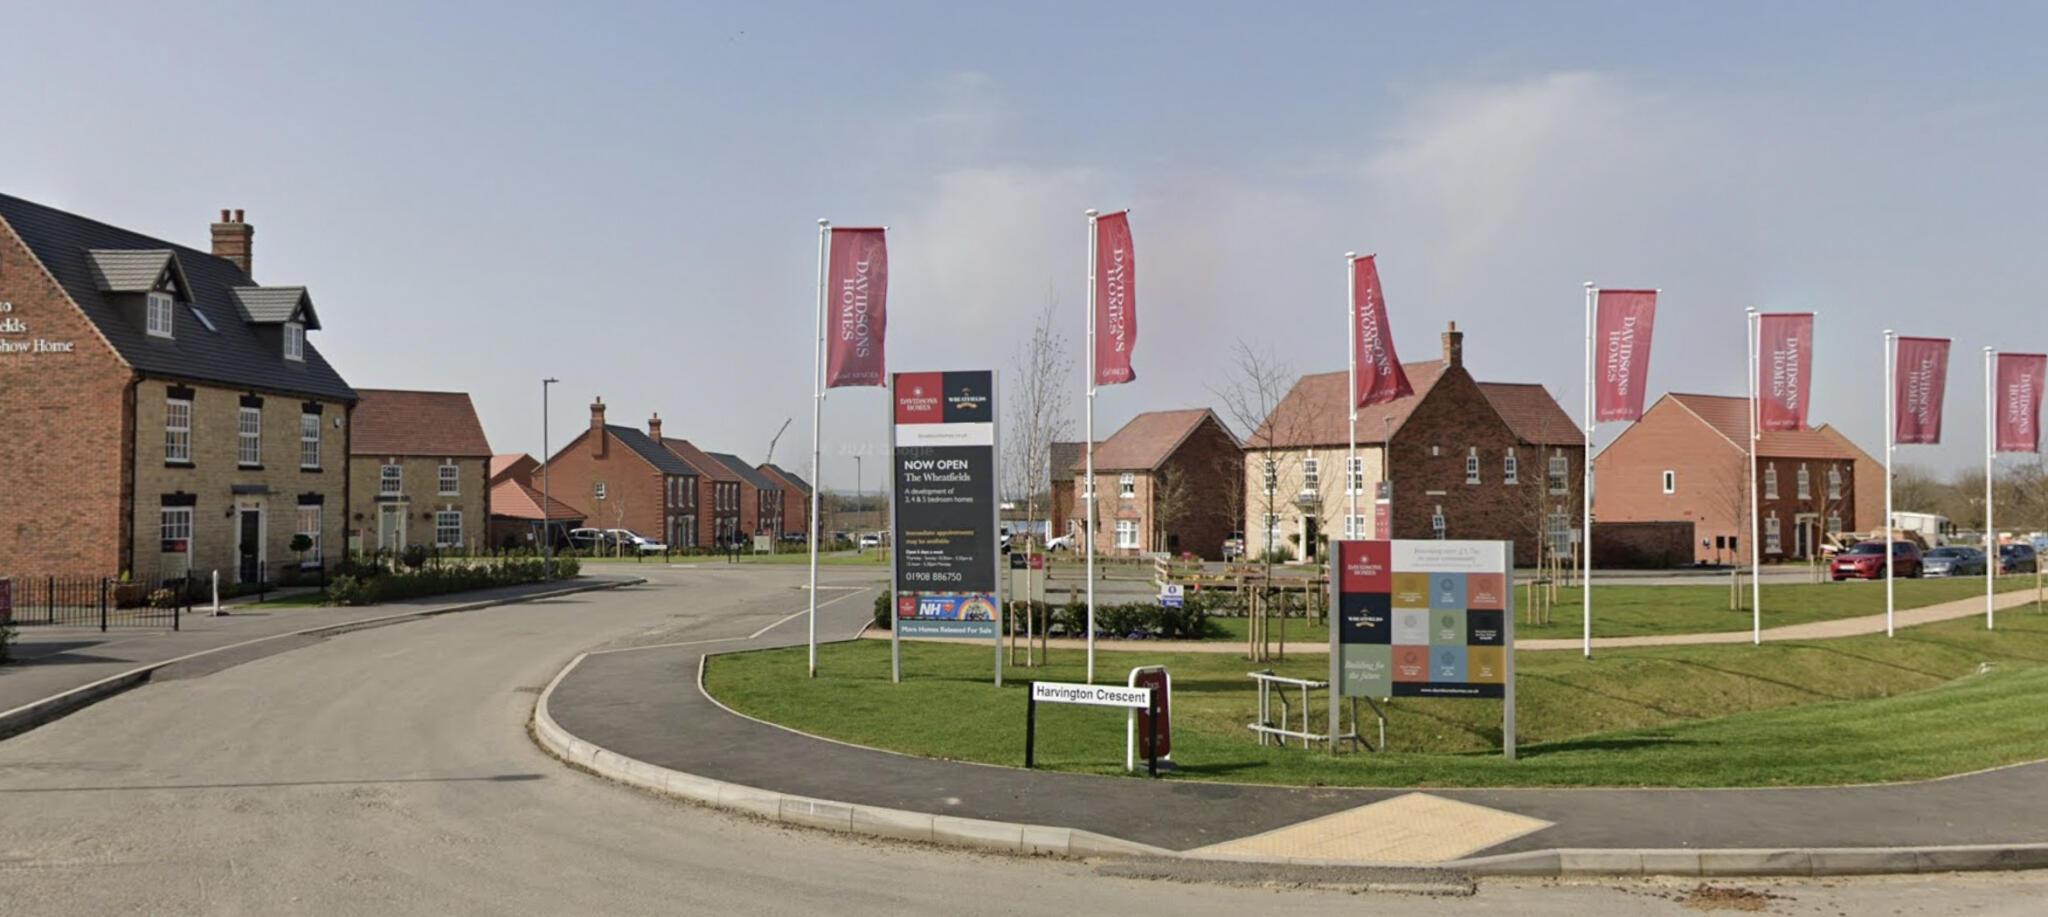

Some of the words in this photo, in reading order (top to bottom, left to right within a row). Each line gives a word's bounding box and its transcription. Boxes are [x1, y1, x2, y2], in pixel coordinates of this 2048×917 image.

[841, 279, 855, 341] HOMES
[855, 260, 870, 358] DAVIDSONS
[1107, 270, 1116, 335] HOMES
[1113, 248, 1125, 353] DAVIDSONS
[33, 339, 74, 352] Home
[1364, 288, 1391, 376] AVIDSONS
[1617, 316, 1637, 396] DAVIDSONS
[1607, 331, 1621, 383] HOMES
[1773, 350, 1785, 397] HOMES
[1785, 337, 1798, 411] DAVIDSONS
[1908, 371, 1920, 413] HOMES
[1919, 359, 1933, 425] DAVIDSONS
[2008, 384, 2019, 424] HOMES
[2020, 373, 2032, 434] DAVIDSONS
[904, 460, 935, 470] NOW
[937, 460, 969, 470] OPEN
[904, 473, 921, 482] The
[923, 472, 971, 482] Wheatfields
[911, 488, 946, 497] development
[947, 487, 955, 495] of
[905, 572, 930, 581] 01908
[932, 572, 962, 581] 886750
[979, 626, 992, 634] Sale
[1036, 686, 1093, 701] Harvington
[1096, 689, 1146, 703] Crescent
